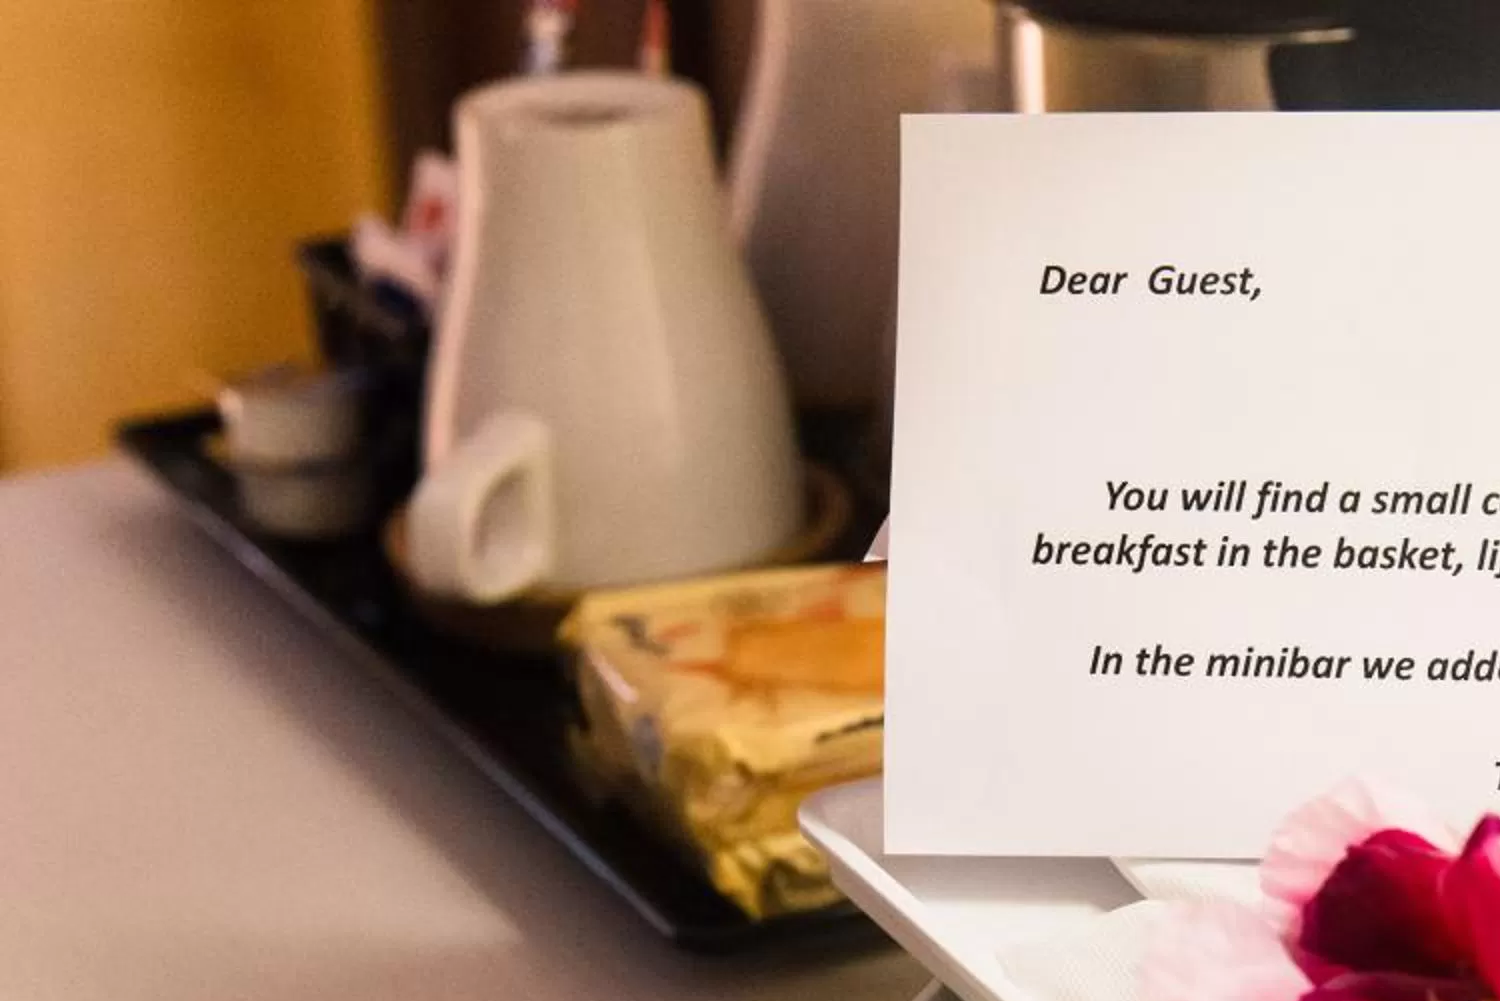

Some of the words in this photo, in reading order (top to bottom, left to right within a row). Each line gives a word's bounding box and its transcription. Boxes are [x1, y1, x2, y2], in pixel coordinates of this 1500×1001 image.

[1039, 265, 1129, 295] Dear
[1148, 265, 1262, 302] Guest,
[1106, 481, 1169, 511] You
[1181, 480, 1247, 513] will
[1252, 480, 1329, 520] find
[1339, 490, 1361, 514] a
[1371, 483, 1473, 515] small
[1031, 532, 1208, 574] breakfast
[1217, 535, 1251, 567] in
[1263, 535, 1322, 569] the
[1333, 536, 1464, 577] basket,
[1089, 645, 1123, 675] In
[1135, 644, 1195, 677] the
[1205, 646, 1352, 679] minibar
[1363, 657, 1415, 681] we
